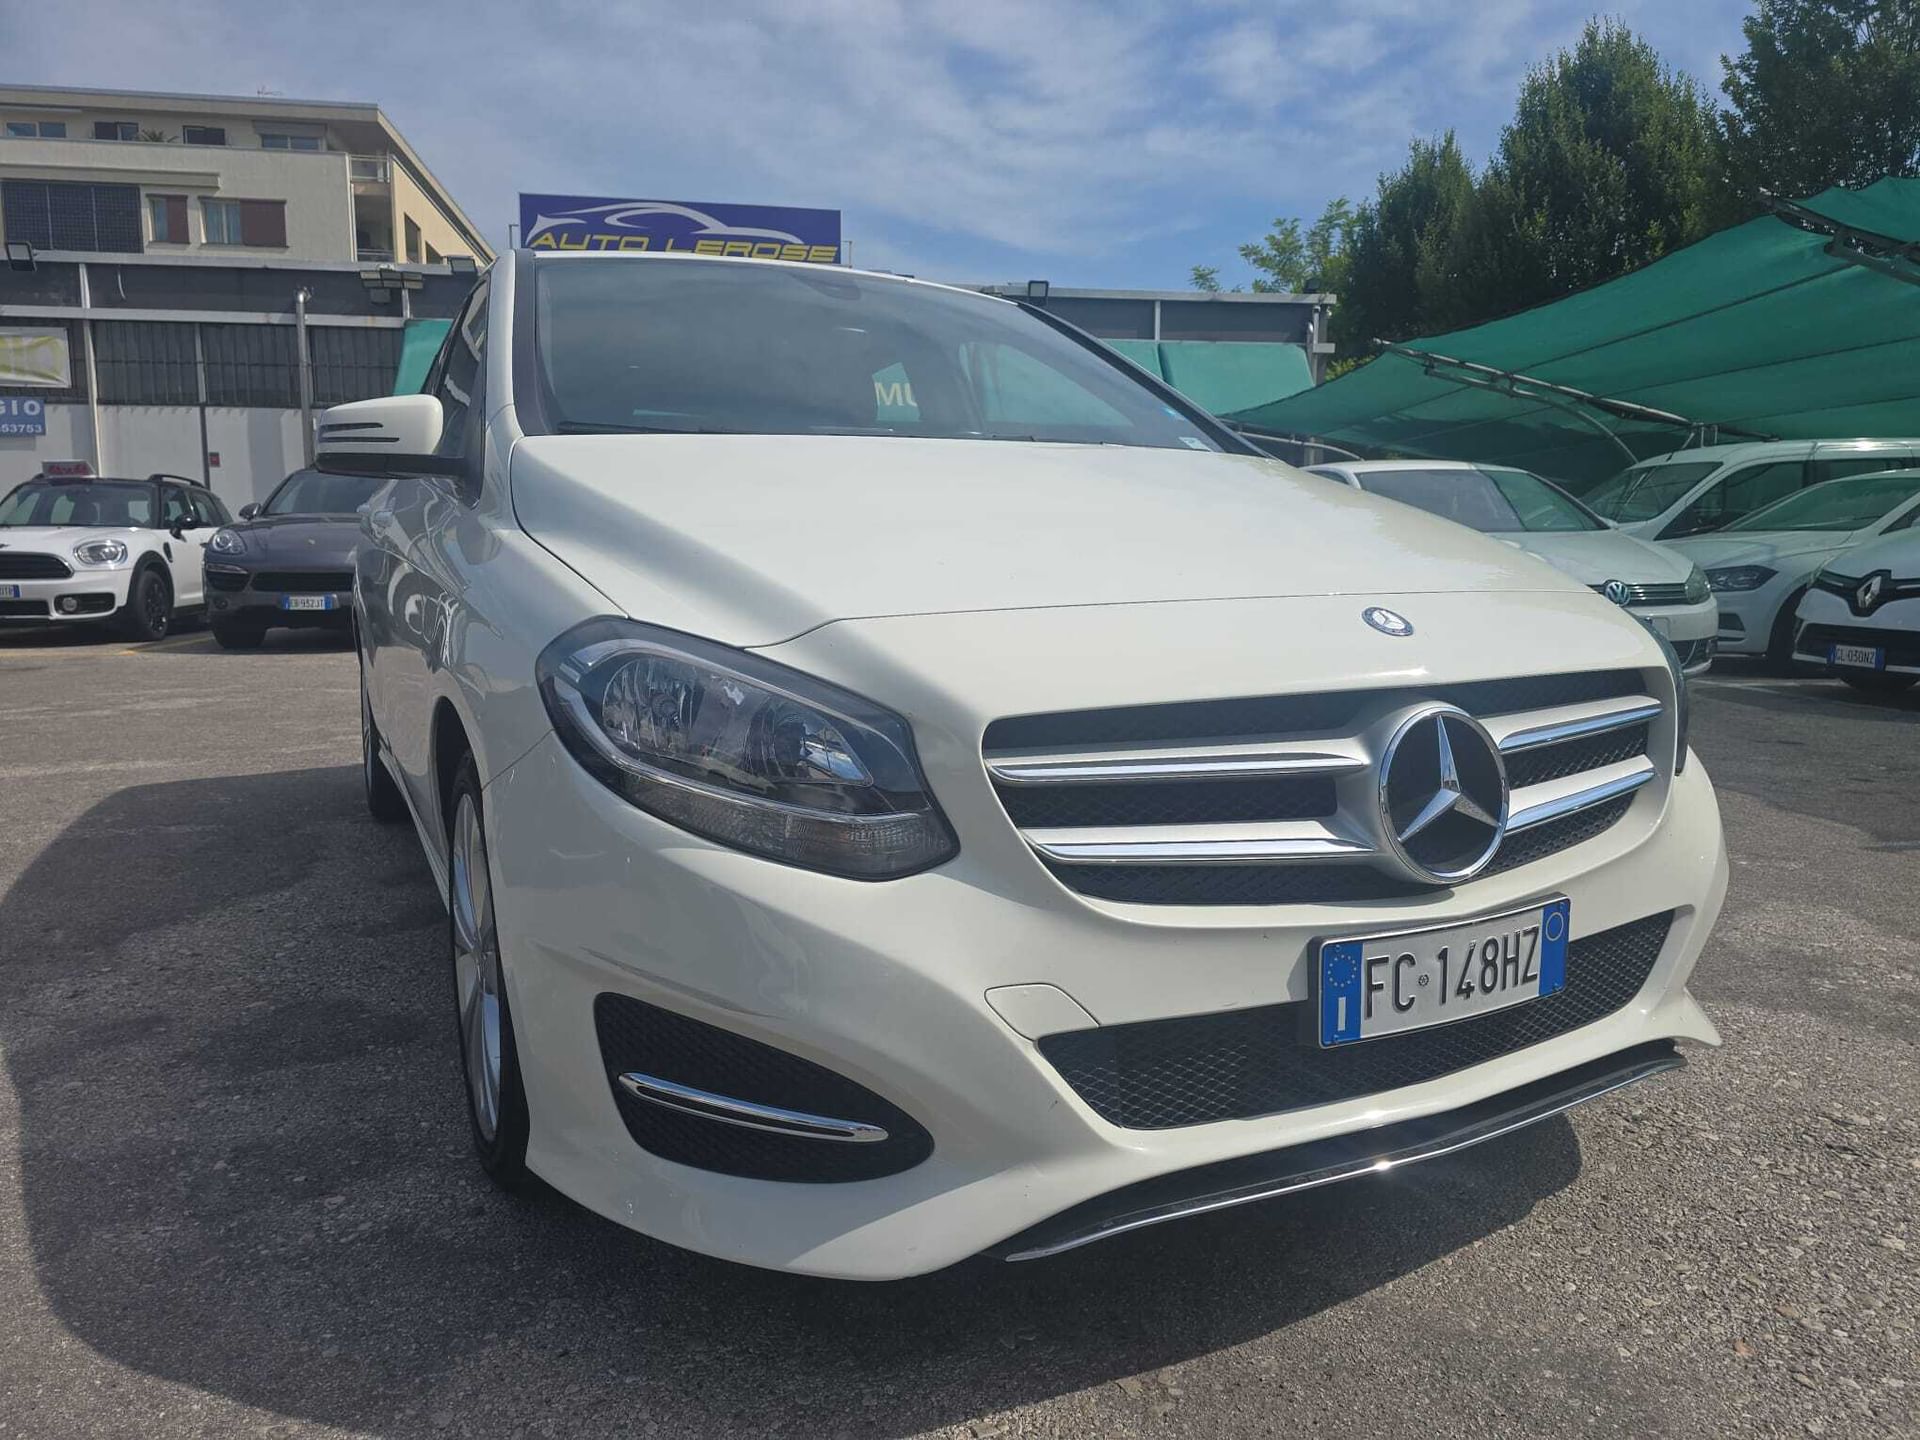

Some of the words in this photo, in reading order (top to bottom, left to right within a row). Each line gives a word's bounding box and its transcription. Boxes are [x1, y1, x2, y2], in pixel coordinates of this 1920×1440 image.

[529, 232, 649, 251] AUTO
[664, 238, 838, 263] LEROSE
[1365, 952, 1417, 1019] FC
[1436, 923, 1541, 1005] 148HZ
